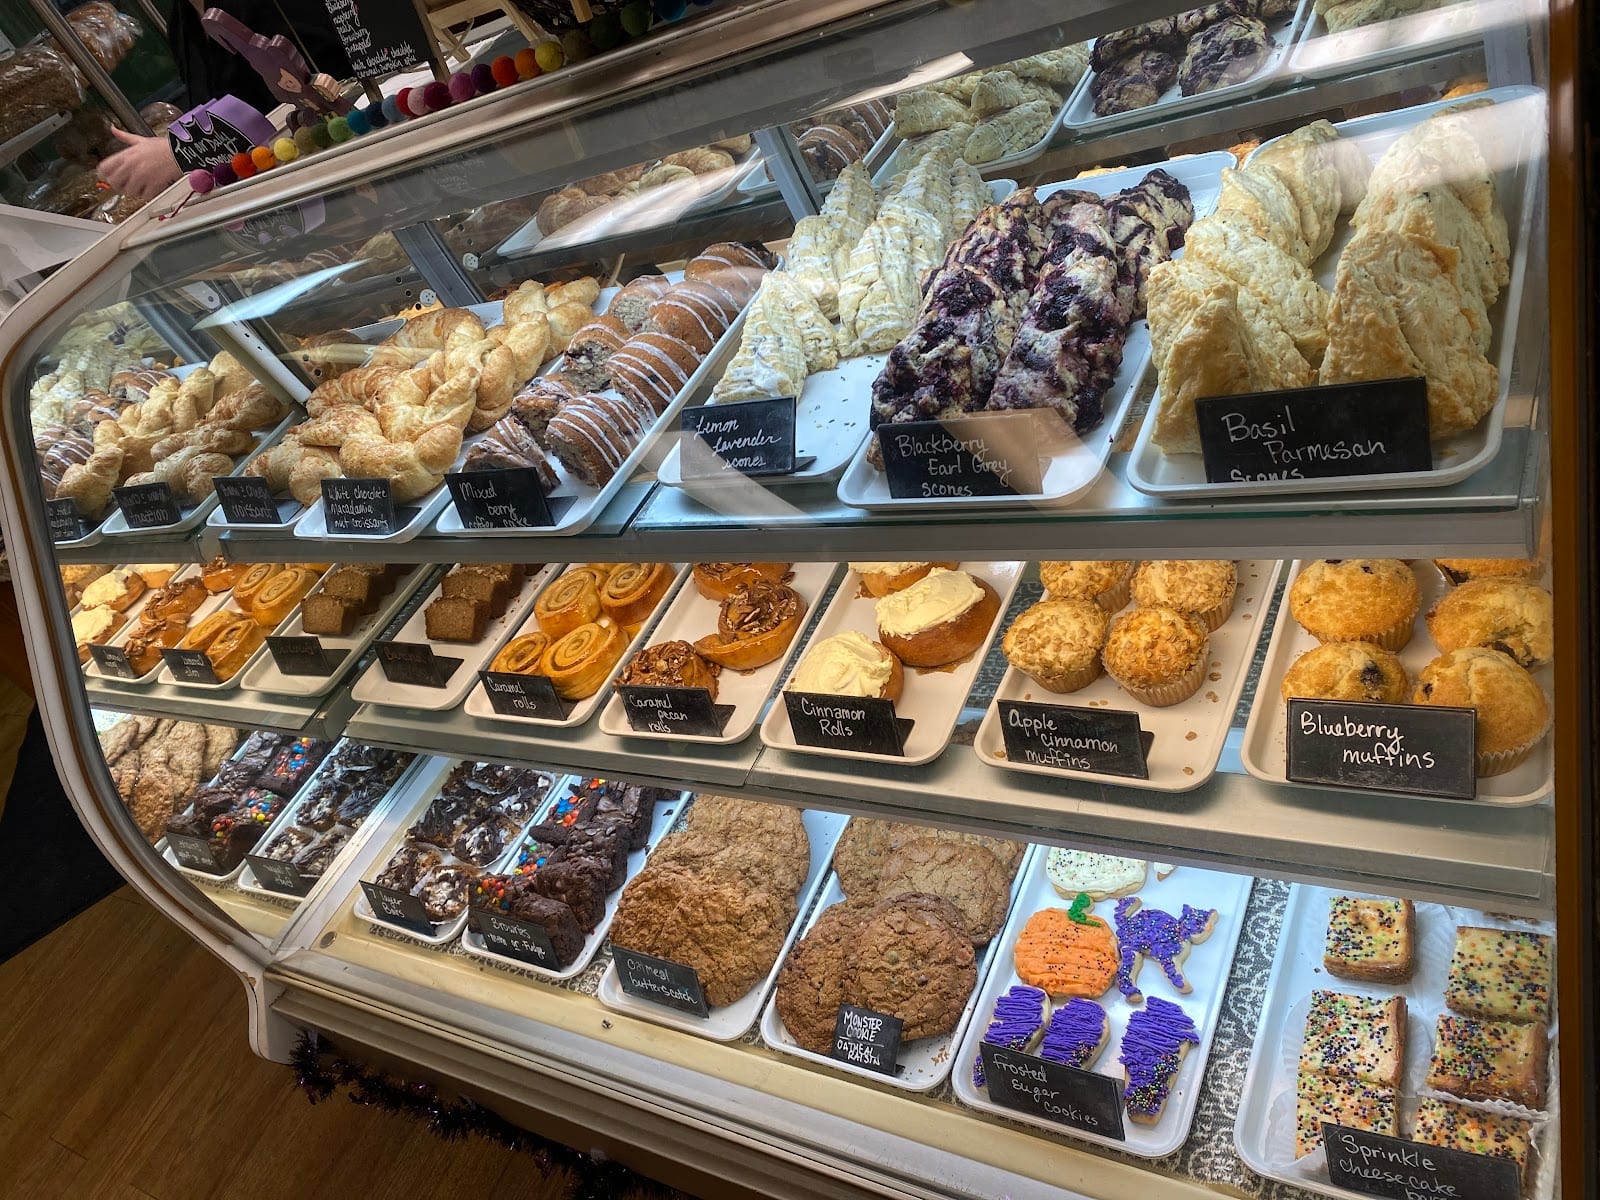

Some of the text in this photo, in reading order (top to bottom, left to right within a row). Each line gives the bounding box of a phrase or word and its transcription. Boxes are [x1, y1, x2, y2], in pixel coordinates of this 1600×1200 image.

[174, 138, 206, 167] Try
[694, 416, 740, 441] Lemon
[1221, 405, 1296, 443] Basil
[712, 429, 782, 457] Lavender
[895, 433, 990, 462] Blackberry
[1263, 439, 1386, 465] Parmesan
[928, 454, 1013, 488] Earl Grey
[460, 480, 498, 501] Mixed
[334, 516, 351, 528] nut
[486, 503, 519, 522] berry
[486, 675, 525, 695] Caramel
[512, 696, 537, 710] rolls
[628, 694, 673, 709] Caramel
[801, 697, 865, 720] Cinnamon
[648, 719, 672, 733] rolls
[656, 709, 688, 724] pecan
[819, 719, 853, 737] Rolls
[1300, 711, 1405, 755] Blueberry
[1025, 748, 1091, 769] muffins
[1343, 742, 1435, 769] muffins
[367, 887, 377, 899] 7
[843, 1011, 883, 1032] MONSTER
[846, 1024, 878, 1042] COOKIE
[837, 1040, 875, 1059] OATMEAL
[847, 1050, 880, 1066] RAISIN
[993, 1053, 1047, 1083] Frosted
[1340, 1134, 1437, 1171] Sprinkle
